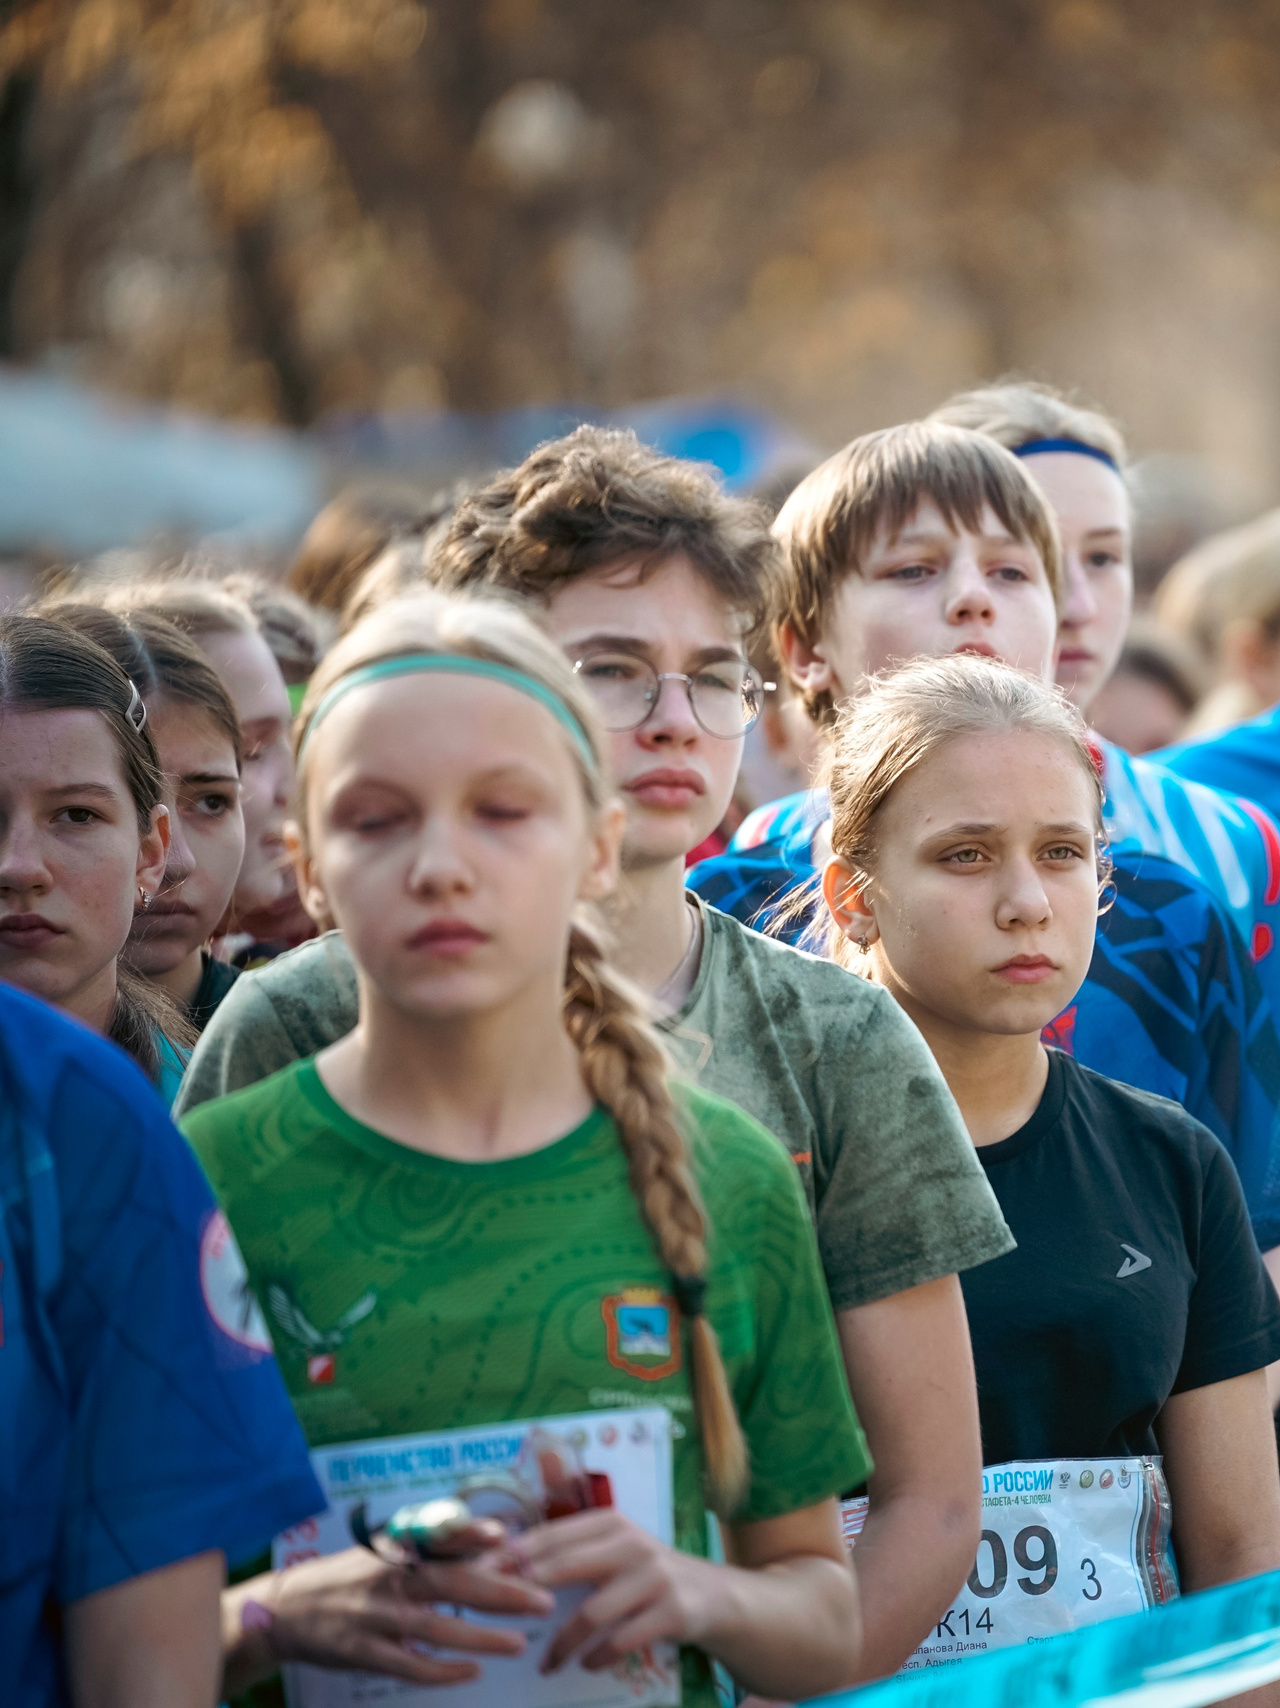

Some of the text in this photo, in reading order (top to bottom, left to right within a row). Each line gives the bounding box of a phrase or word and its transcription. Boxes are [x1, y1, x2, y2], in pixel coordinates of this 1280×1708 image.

[993, 1470, 1054, 1493] РОССИИ
[1080, 1558, 1102, 1600] 3
[956, 1641, 987, 1653] Диана
[925, 1657, 962, 1668] Адыгея
